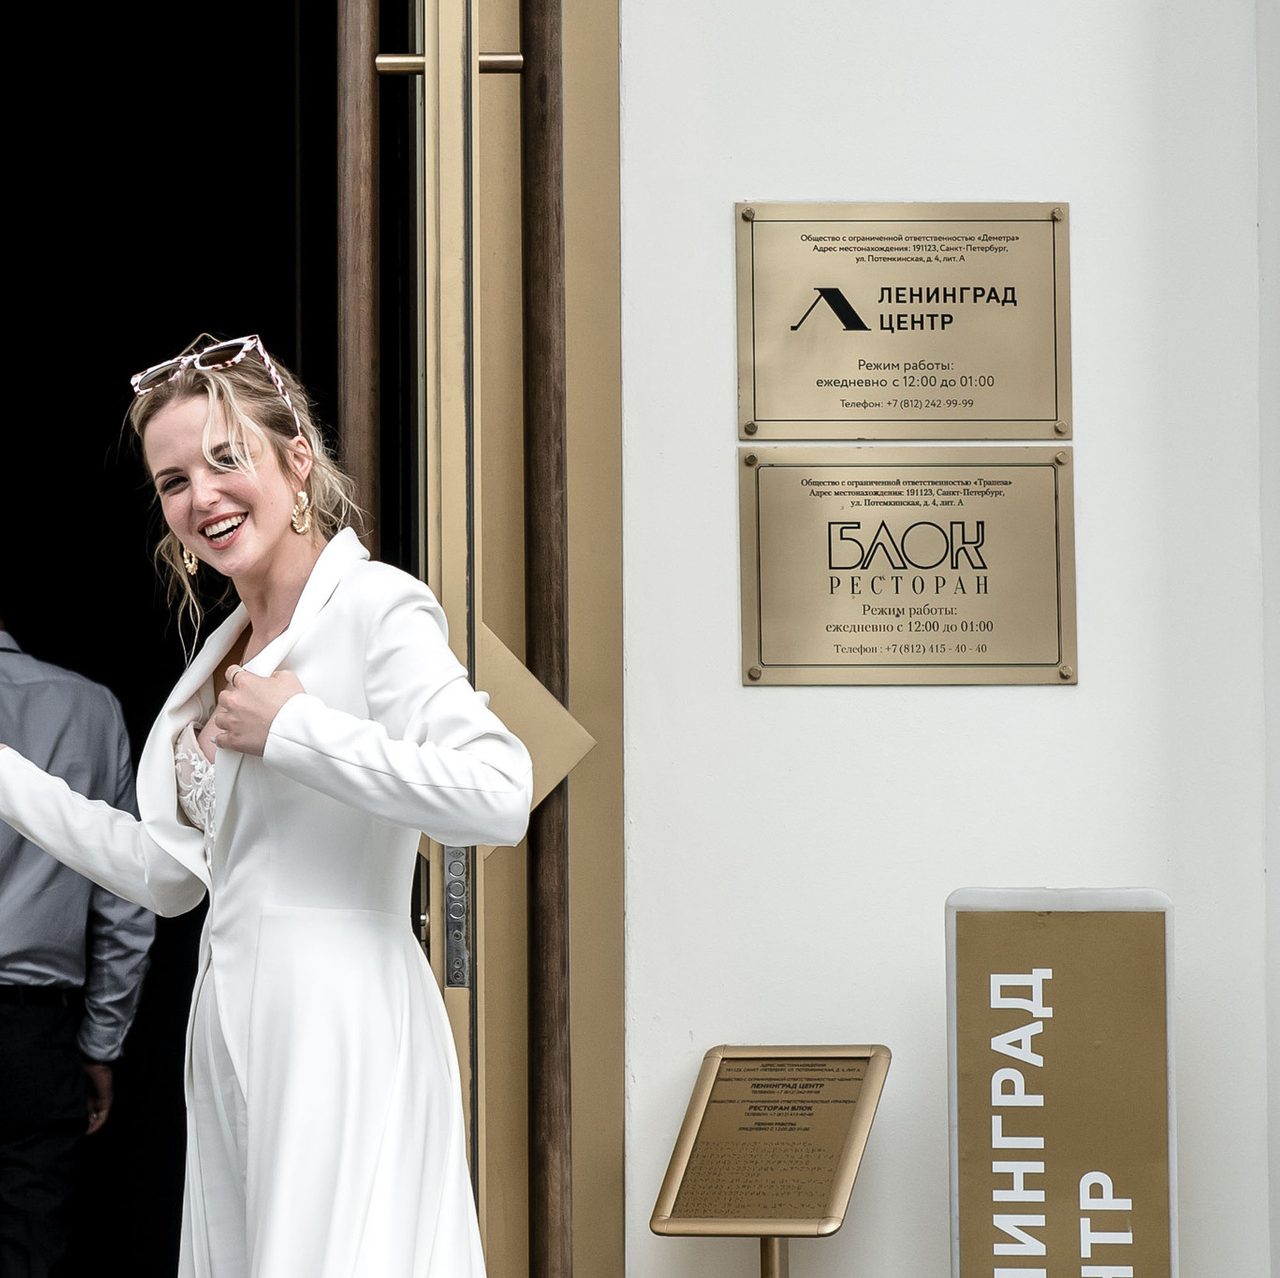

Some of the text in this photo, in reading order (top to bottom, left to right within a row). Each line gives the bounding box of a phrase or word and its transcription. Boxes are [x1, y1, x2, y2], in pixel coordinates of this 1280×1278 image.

[800, 234, 1019, 242] Общество с ограниченной ответственностью «Деметра»
[813, 244, 1009, 253] Адрес местонахождения: 191123, Санкт-Петербург,
[855, 255, 965, 263] ул. Потемкинская, д. 4, лит. А
[878, 287, 1017, 306] ЛЕНИНГРАД
[880, 314, 954, 333] ЦЕНТР
[858, 359, 954, 373] Режим работы:
[816, 376, 994, 389] ежедневно с 12:00 до 01:00
[840, 399, 974, 410] Телефон: +7 (812) 242-99-99
[801, 478, 1013, 487] Общество с ограниченной ответственностью «Трапеза»
[809, 489, 1005, 497] Адрес местонахождения: 191123, Санкт-Петербург,
[851, 499, 964, 507] ул. Потемкинская, д. 4, лит. А
[828, 519, 988, 570] БЛОК
[829, 575, 989, 595] РЕСТОРАН
[862, 603, 957, 618] Режим работы:
[826, 620, 994, 634] ежедневно с 12:00 до 01:00
[885, 645, 897, 653] +7
[899, 644, 926, 655] (812)
